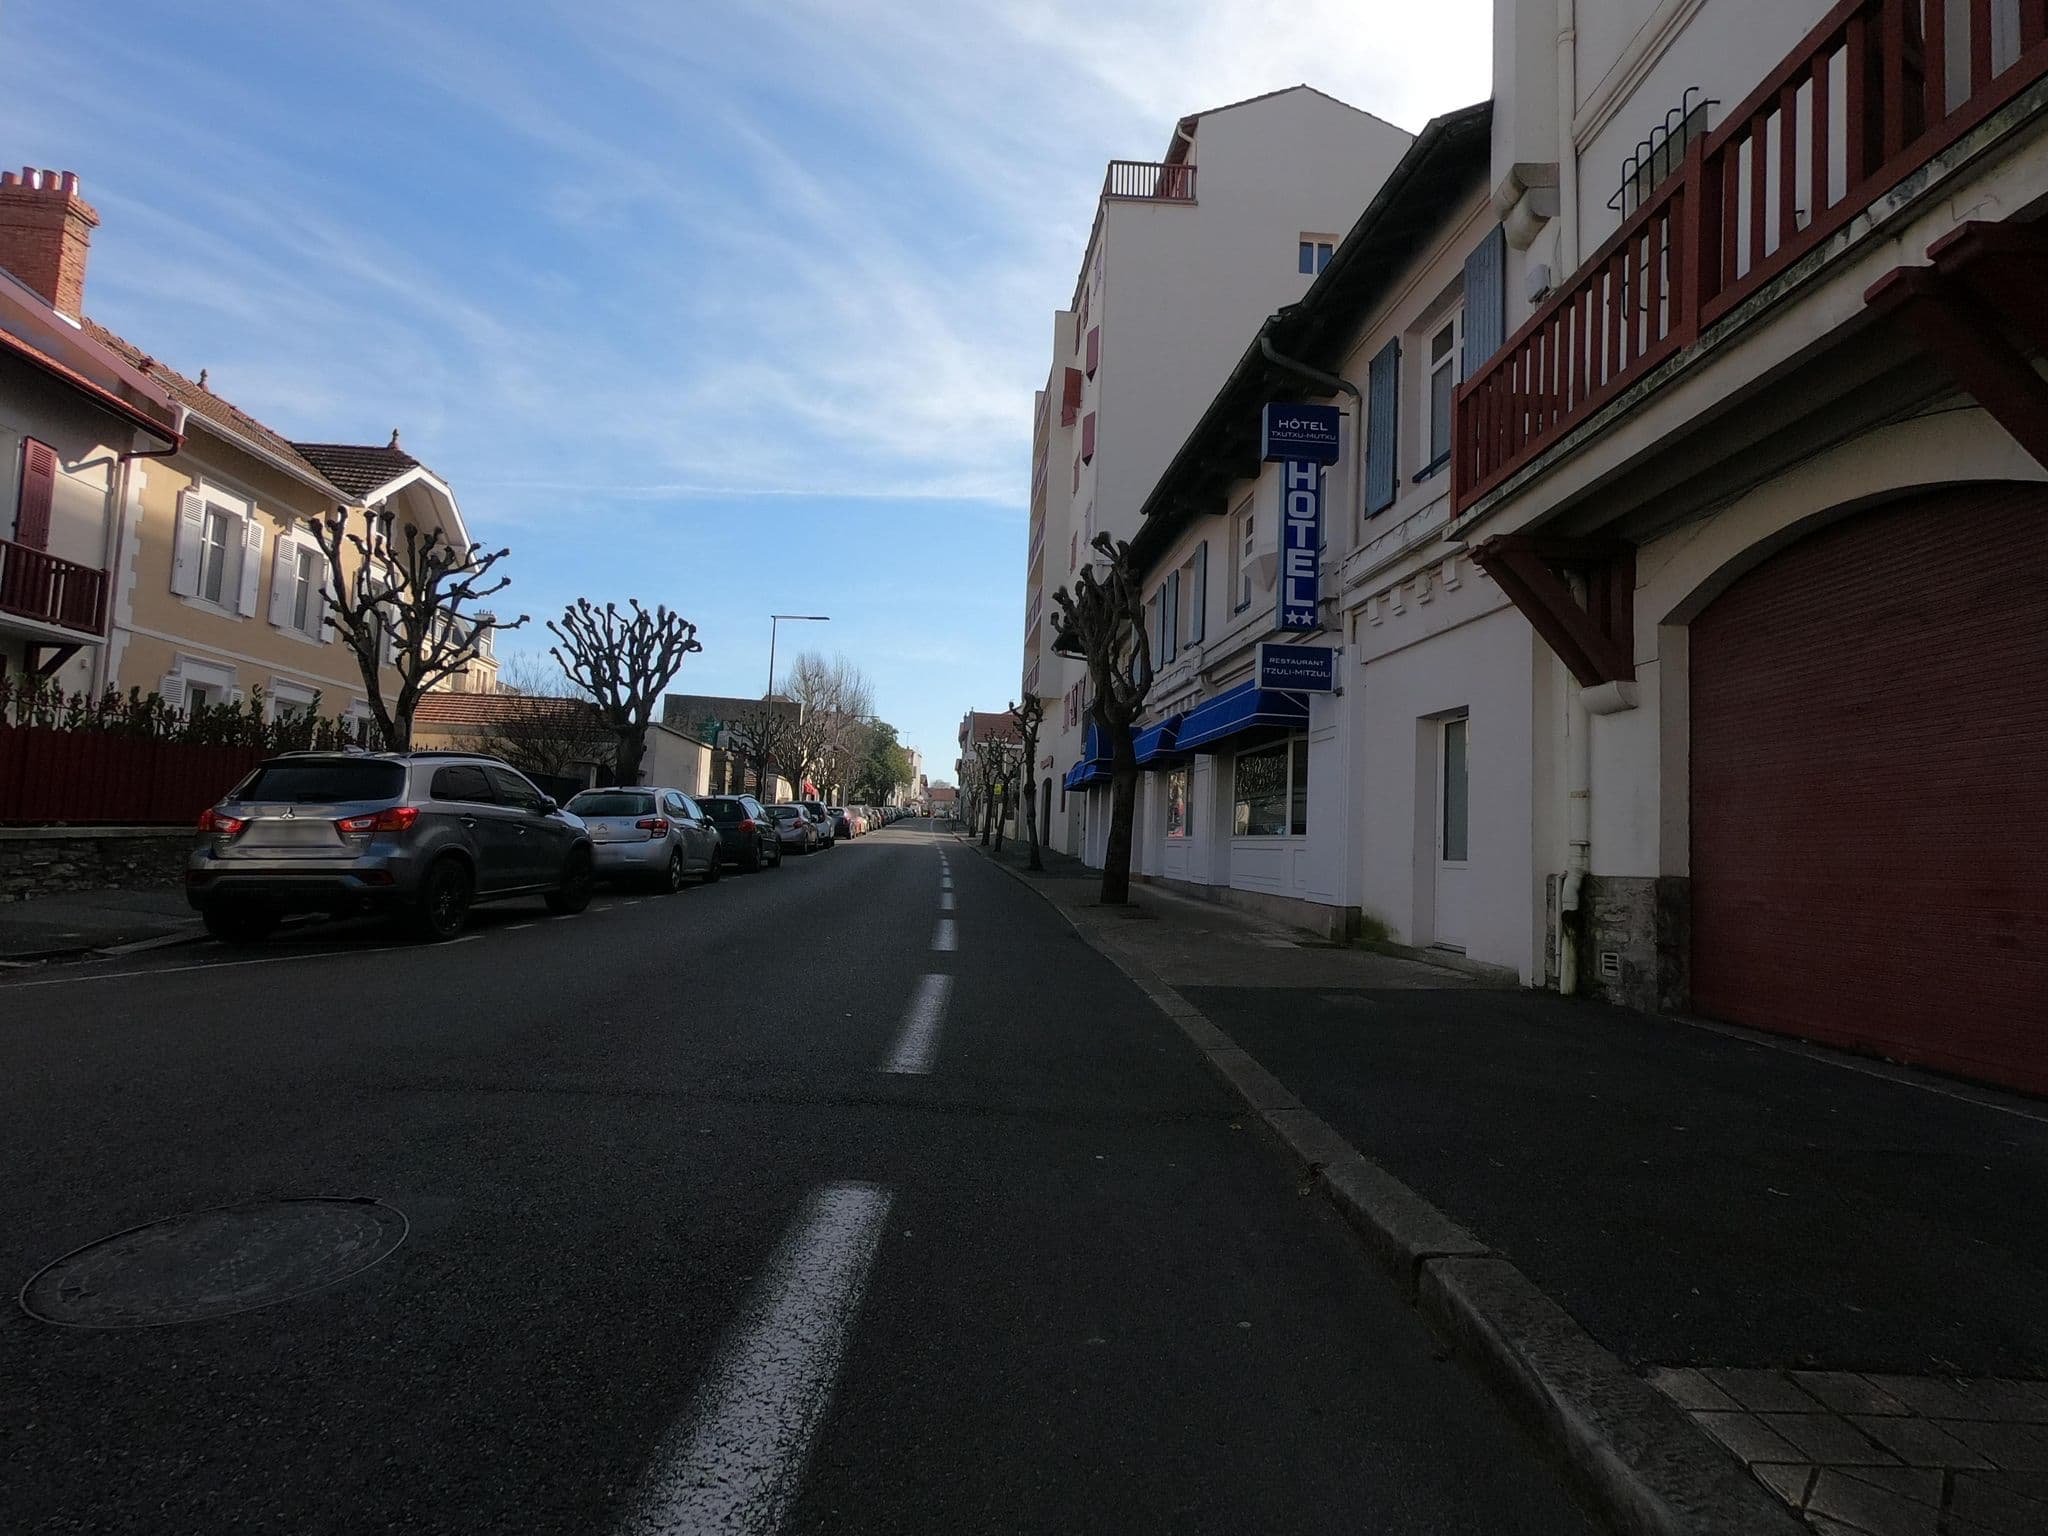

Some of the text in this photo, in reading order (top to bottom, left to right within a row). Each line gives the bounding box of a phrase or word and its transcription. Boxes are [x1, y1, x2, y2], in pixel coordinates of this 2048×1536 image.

[1278, 418, 1328, 431] HÔTEL
[1286, 461, 1317, 607] HOTEL
[1269, 657, 1325, 667] RESTAURANT
[1263, 667, 1331, 678] ITZULI-MITZULI
